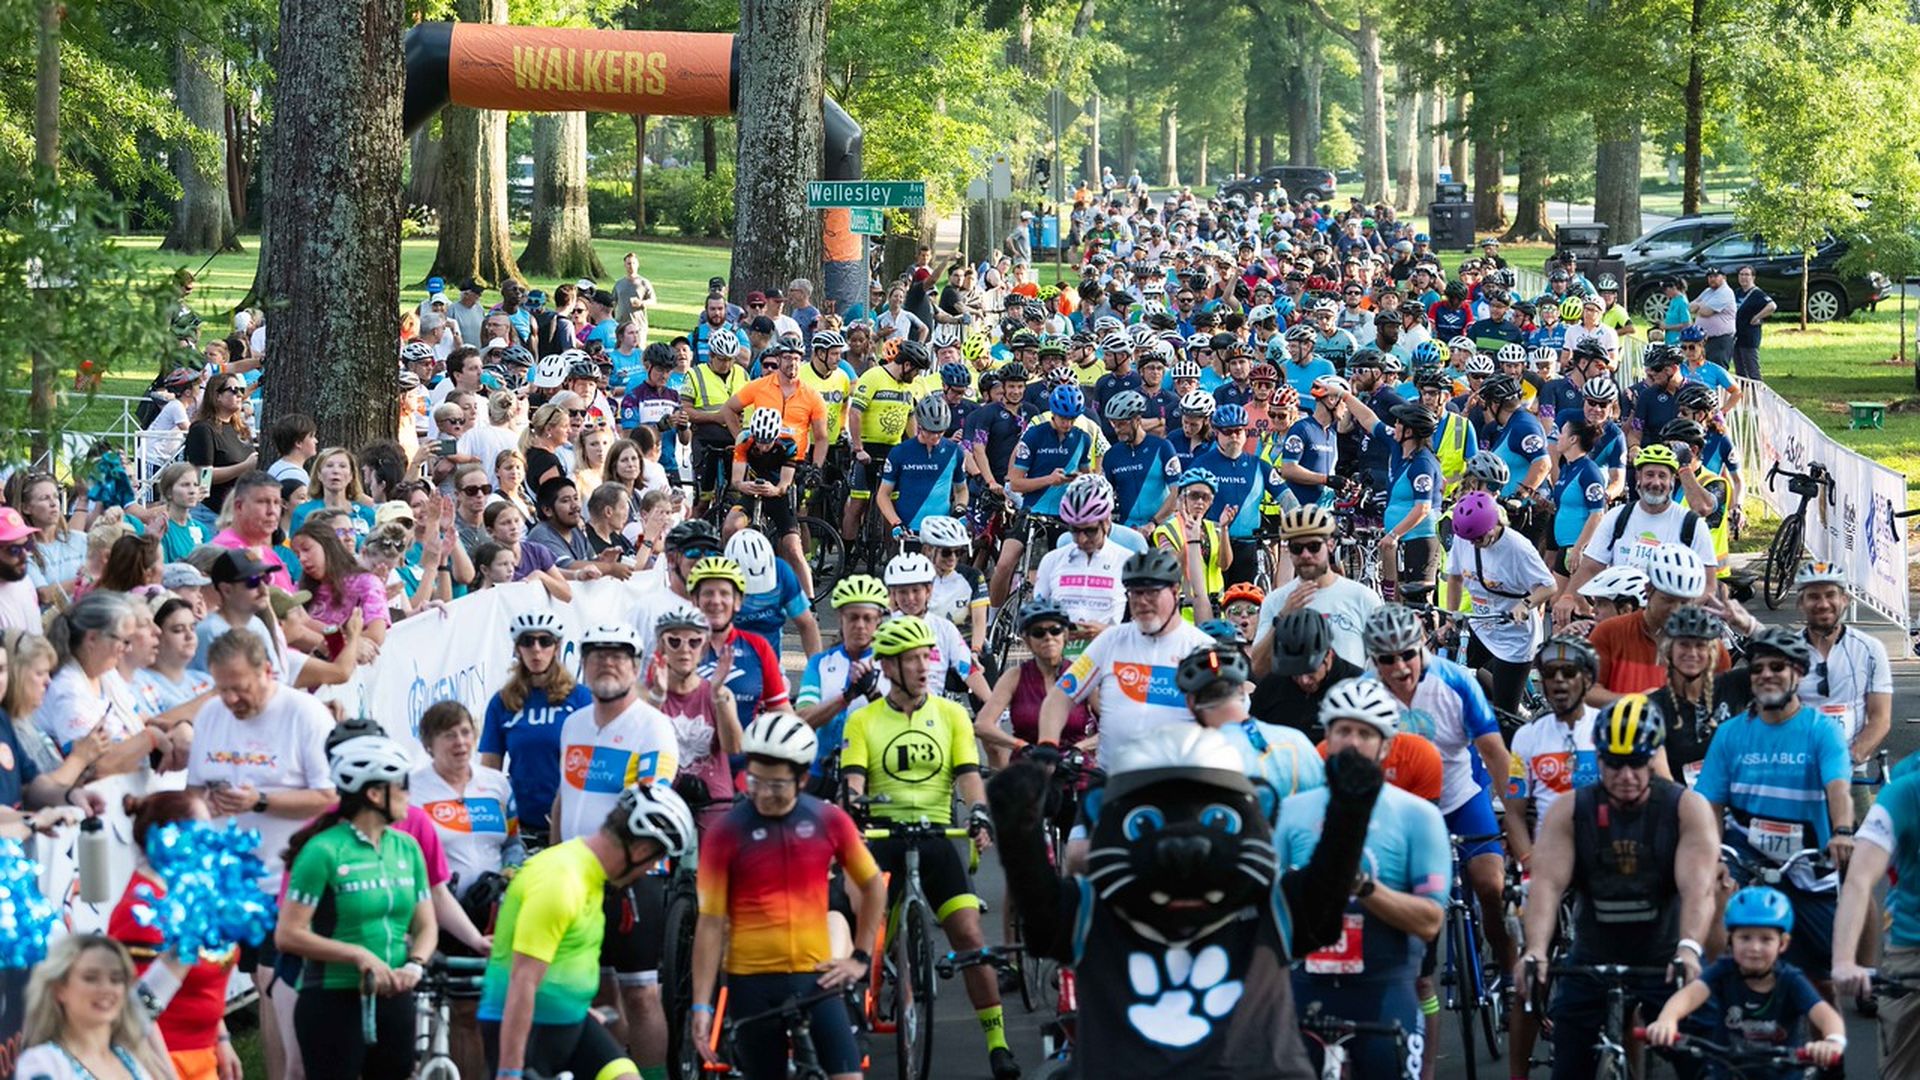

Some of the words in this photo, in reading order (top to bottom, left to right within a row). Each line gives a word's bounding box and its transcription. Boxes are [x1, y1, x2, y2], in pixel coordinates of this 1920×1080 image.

[513, 46, 668, 96] WALKERS
[810, 184, 892, 205] Wellesley
[910, 184, 923, 193] Ave
[902, 463, 939, 471] AMWINS
[894, 743, 936, 773] F3
[1769, 752, 1811, 765] ABLO
[1759, 833, 1791, 854] 1171
